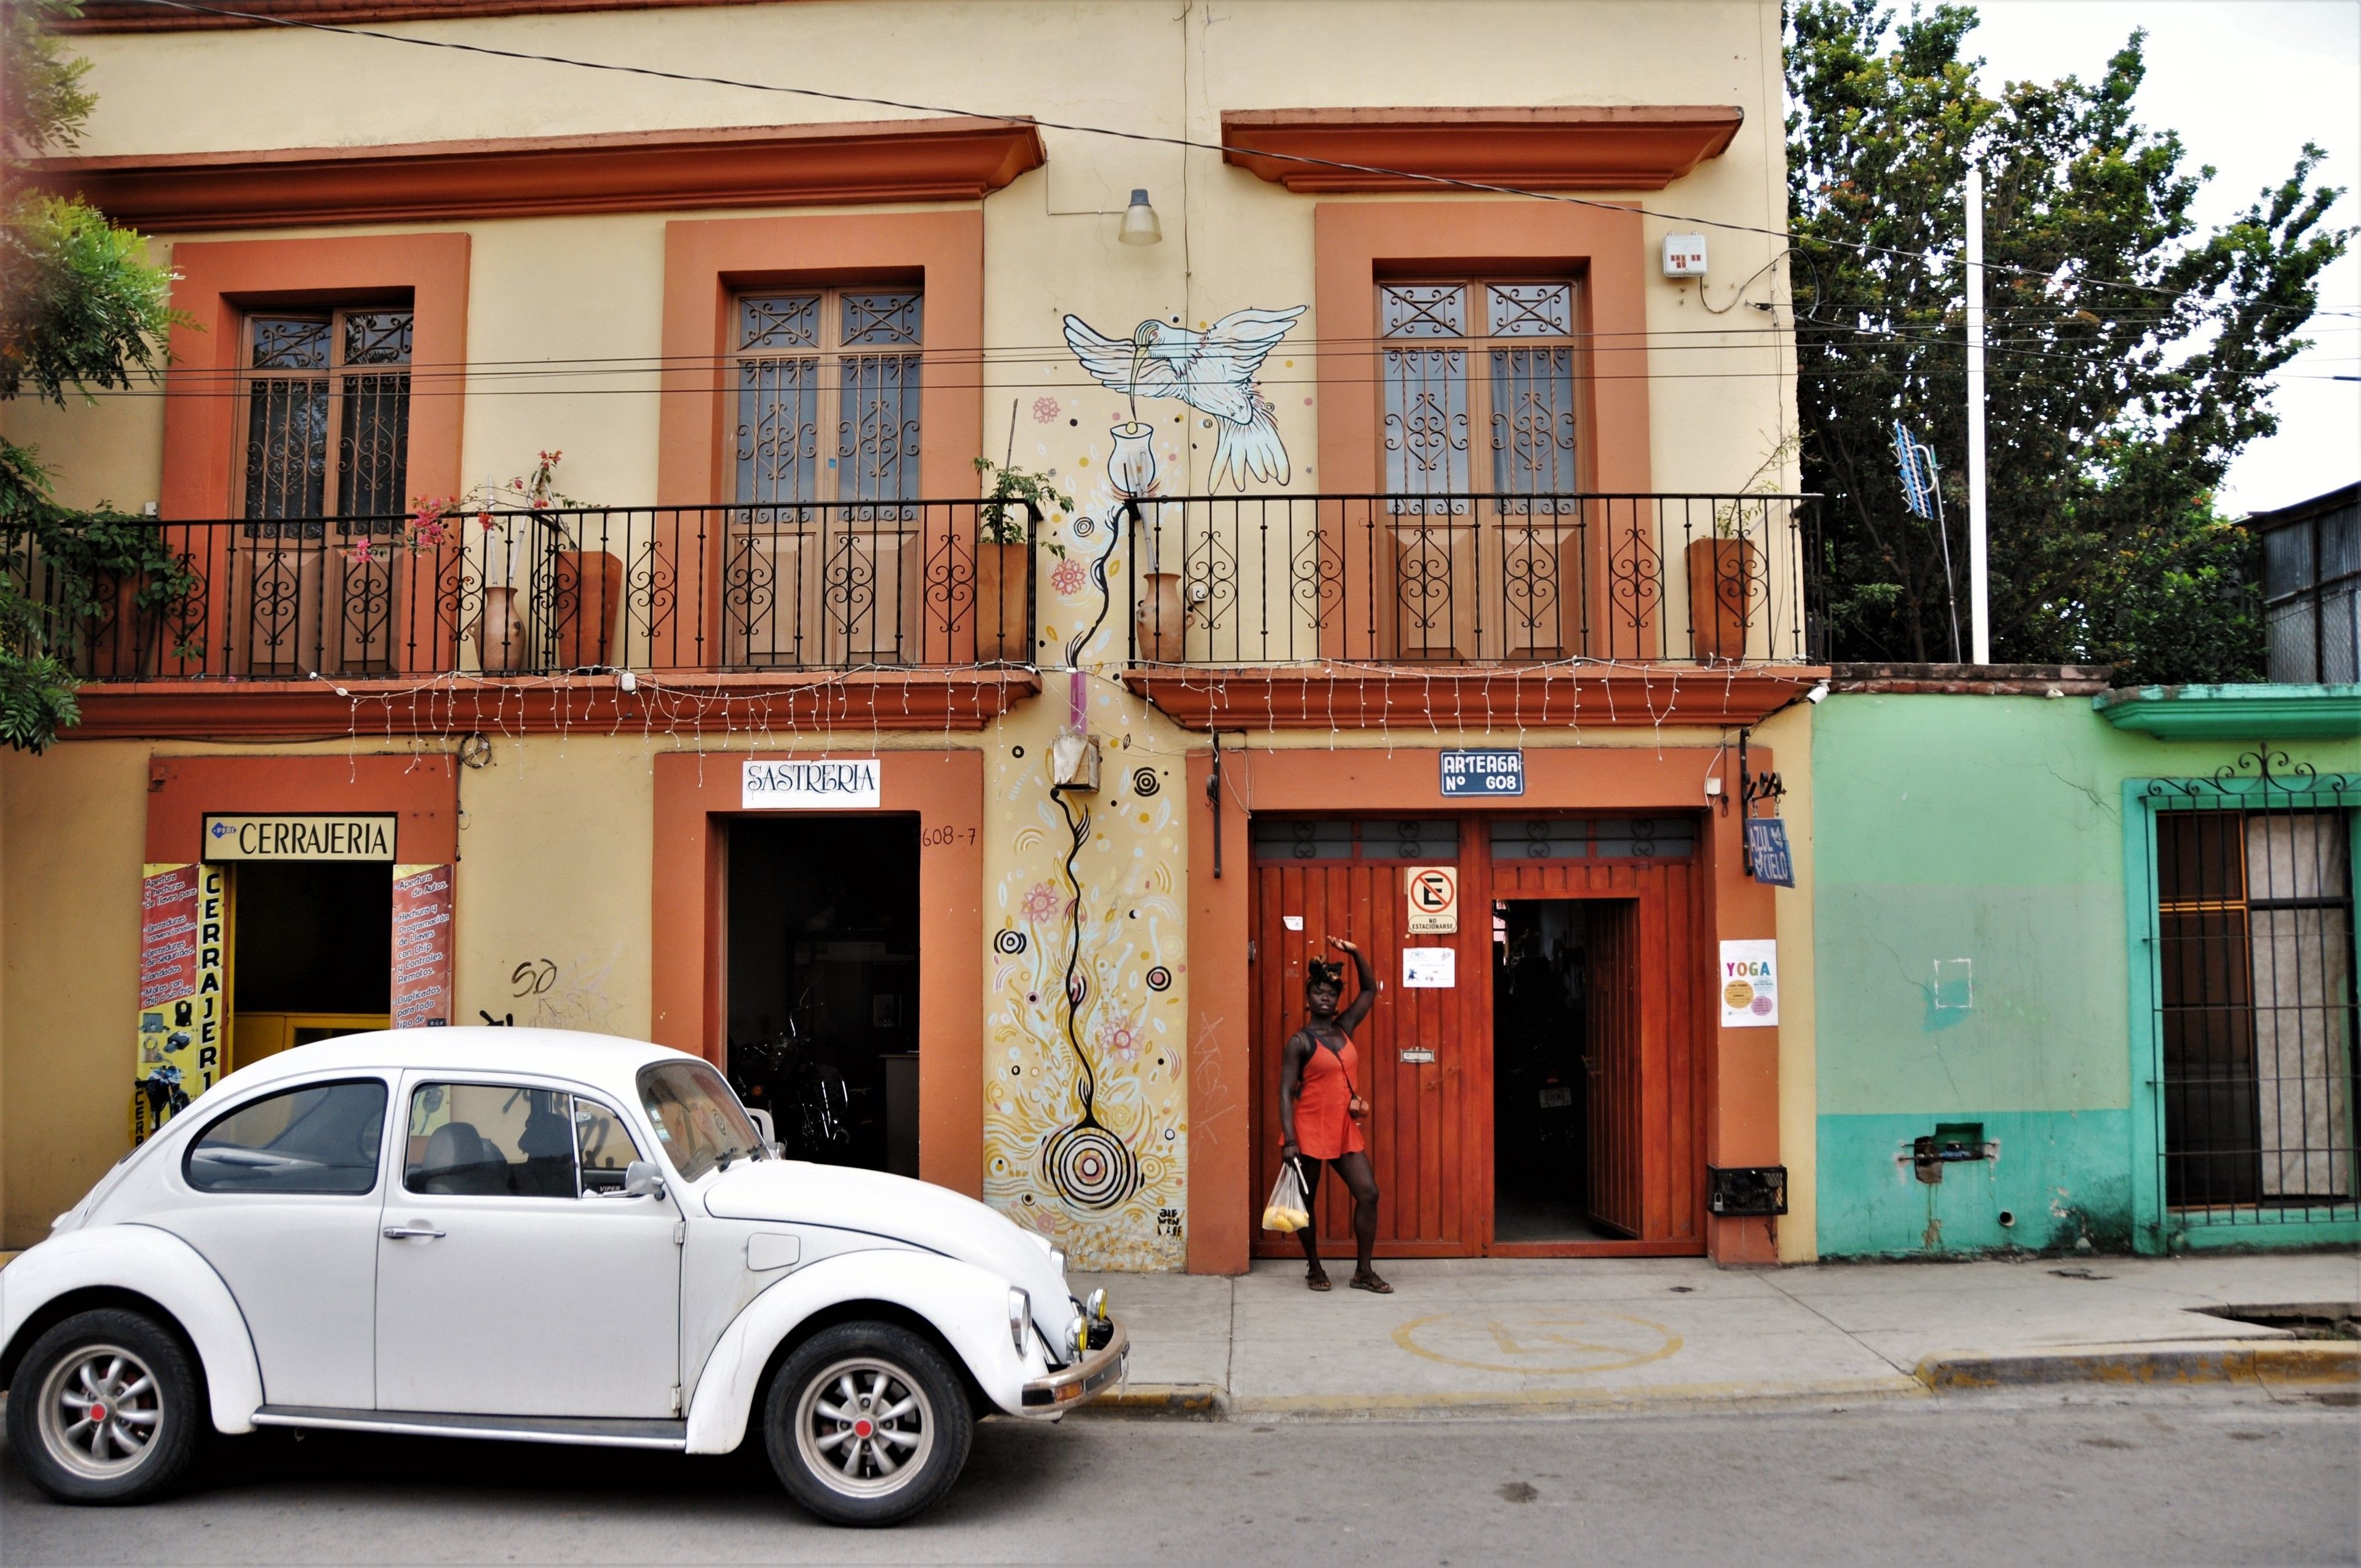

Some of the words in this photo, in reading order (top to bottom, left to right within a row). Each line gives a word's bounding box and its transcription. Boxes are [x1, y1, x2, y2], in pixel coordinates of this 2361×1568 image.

[1444, 756, 1518, 773] ARTEAGA
[748, 764, 876, 794] SASTRERIA
[1485, 775, 1517, 790] 608
[239, 823, 388, 854] CERRAJERIA
[1749, 826, 1773, 853] AZUL
[1763, 851, 1788, 880] CIELO
[146, 874, 176, 887] Apertura
[399, 874, 432, 889] Apertura
[152, 882, 185, 896] hechuras
[413, 889, 422, 897] de
[145, 900, 155, 908] de
[157, 894, 178, 905] llaves
[180, 888, 197, 900] para
[399, 907, 430, 921] Hechura
[431, 905, 438, 913] y
[148, 916, 186, 932] Cerraduras
[410, 930, 435, 943] Llaves
[148, 941, 185, 957] Cerraduras
[398, 950, 411, 959] con
[414, 943, 432, 954] Chip
[406, 952, 442, 968] Controles
[146, 965, 181, 981] Candados
[1726, 962, 1771, 976] YOGA
[146, 984, 168, 995] Motos
[398, 986, 441, 1004] Duplicados
[145, 997, 159, 1006] chip
[398, 1007, 414, 1018] para
[416, 1000, 434, 1011] todo
[397, 1019, 413, 1029] tipo
[415, 1015, 425, 1024] de
